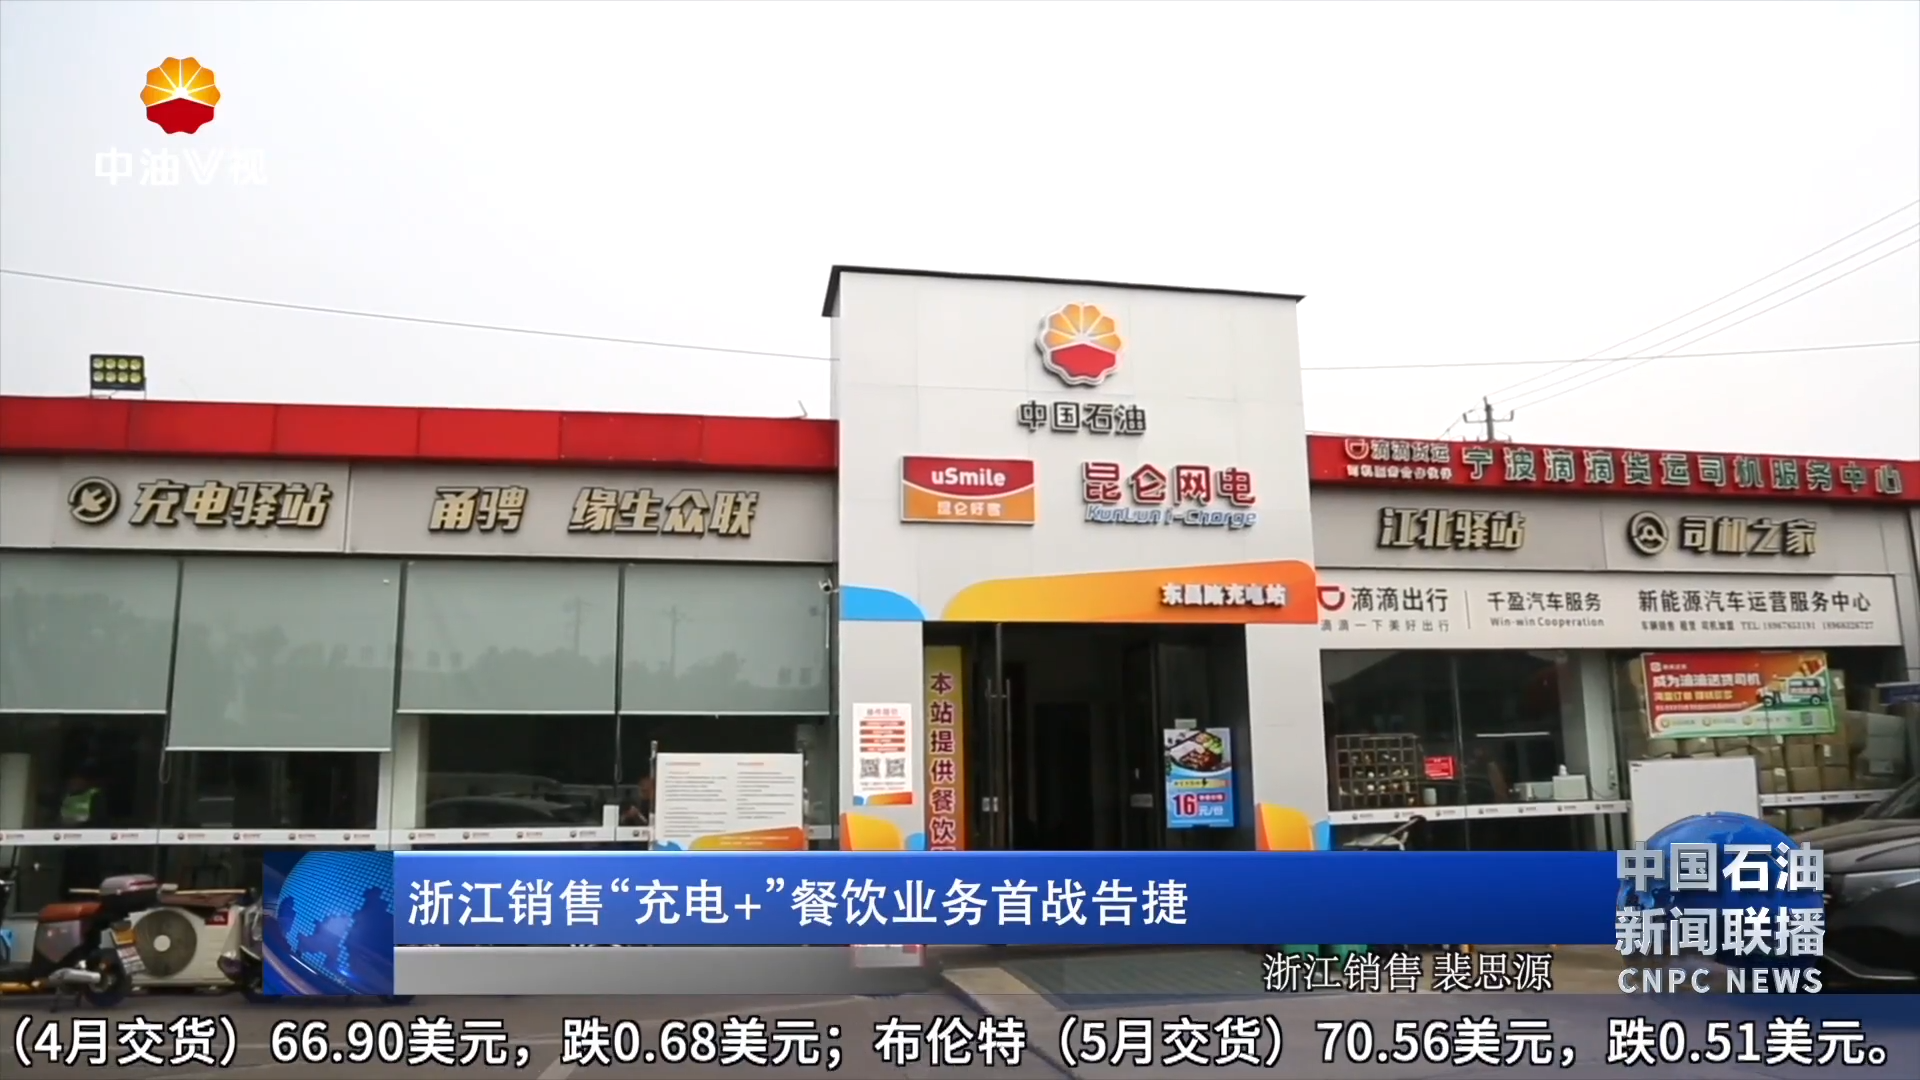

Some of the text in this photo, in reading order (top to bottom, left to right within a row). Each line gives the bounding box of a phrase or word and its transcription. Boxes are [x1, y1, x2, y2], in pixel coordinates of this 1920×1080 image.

[1017, 400, 1147, 435] 中国石油
[930, 466, 1007, 488] uSmile
[1083, 461, 1256, 507] 昆仑网电
[1461, 446, 1903, 494] 宁波滴滴货运司机服务中心
[129, 479, 333, 527] 充电驿站
[428, 484, 528, 534] 甬聘
[567, 486, 760, 537] 缘生众联
[936, 500, 1002, 517] 昆仑好客
[1379, 508, 1526, 550] 江北驿站
[1681, 515, 1818, 555] 司机之家
[1350, 587, 1449, 613] 滴滴出行
[1487, 592, 1602, 612] 千盈汽车服务
[1638, 589, 1872, 613] 新能源汽车运营服务中心
[1320, 619, 1450, 633] 滴滴一下美好出行
[1490, 616, 1605, 629] Win-win Cooperation
[930, 671, 955, 851] 本站提供餐饮
[1172, 793, 1196, 816] 16
